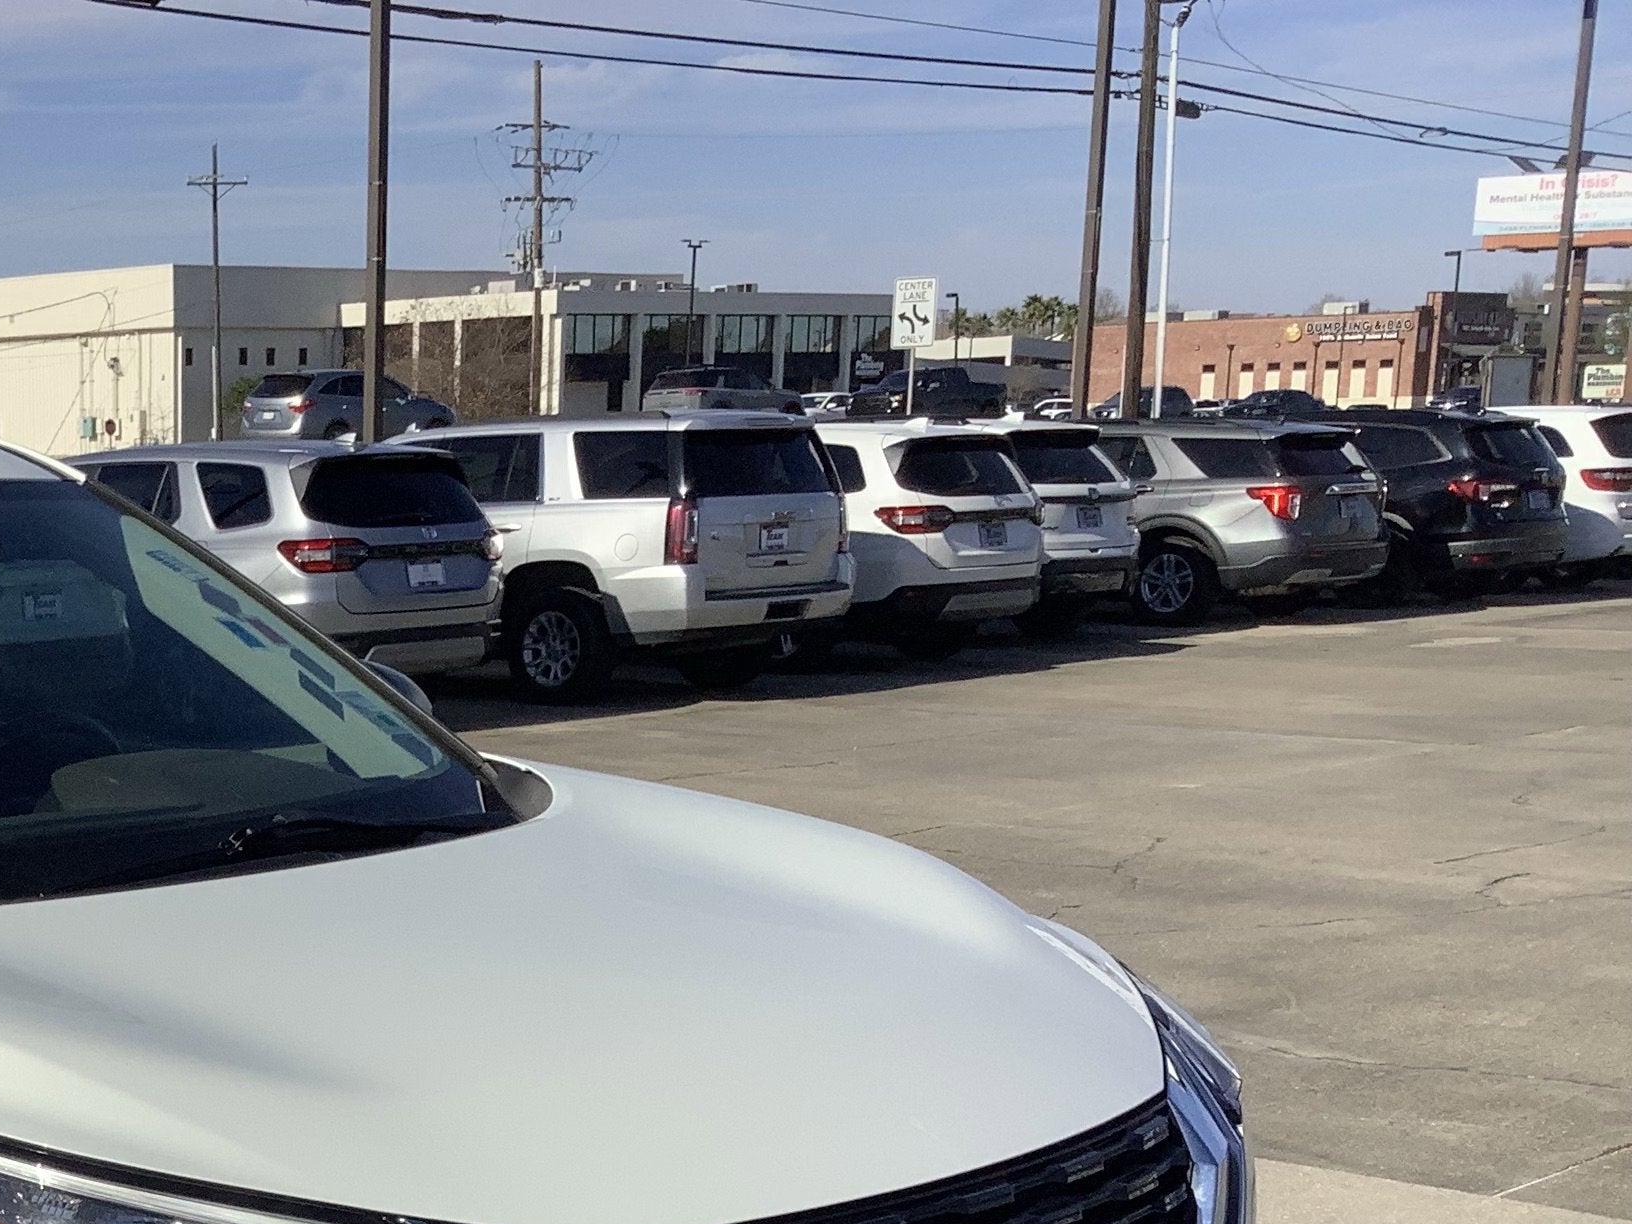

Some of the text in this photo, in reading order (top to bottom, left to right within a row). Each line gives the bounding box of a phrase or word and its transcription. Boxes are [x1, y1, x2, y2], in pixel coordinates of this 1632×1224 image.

[1539, 174, 1619, 190] In Cisis?
[1489, 193, 1528, 204] Mental
[898, 281, 934, 292] CENTER
[903, 291, 928, 301] LANE
[1386, 318, 1414, 332] BAO
[900, 335, 926, 345] ONLY
[1595, 367, 1611, 375] The
[1588, 372, 1624, 382] Plumbin
